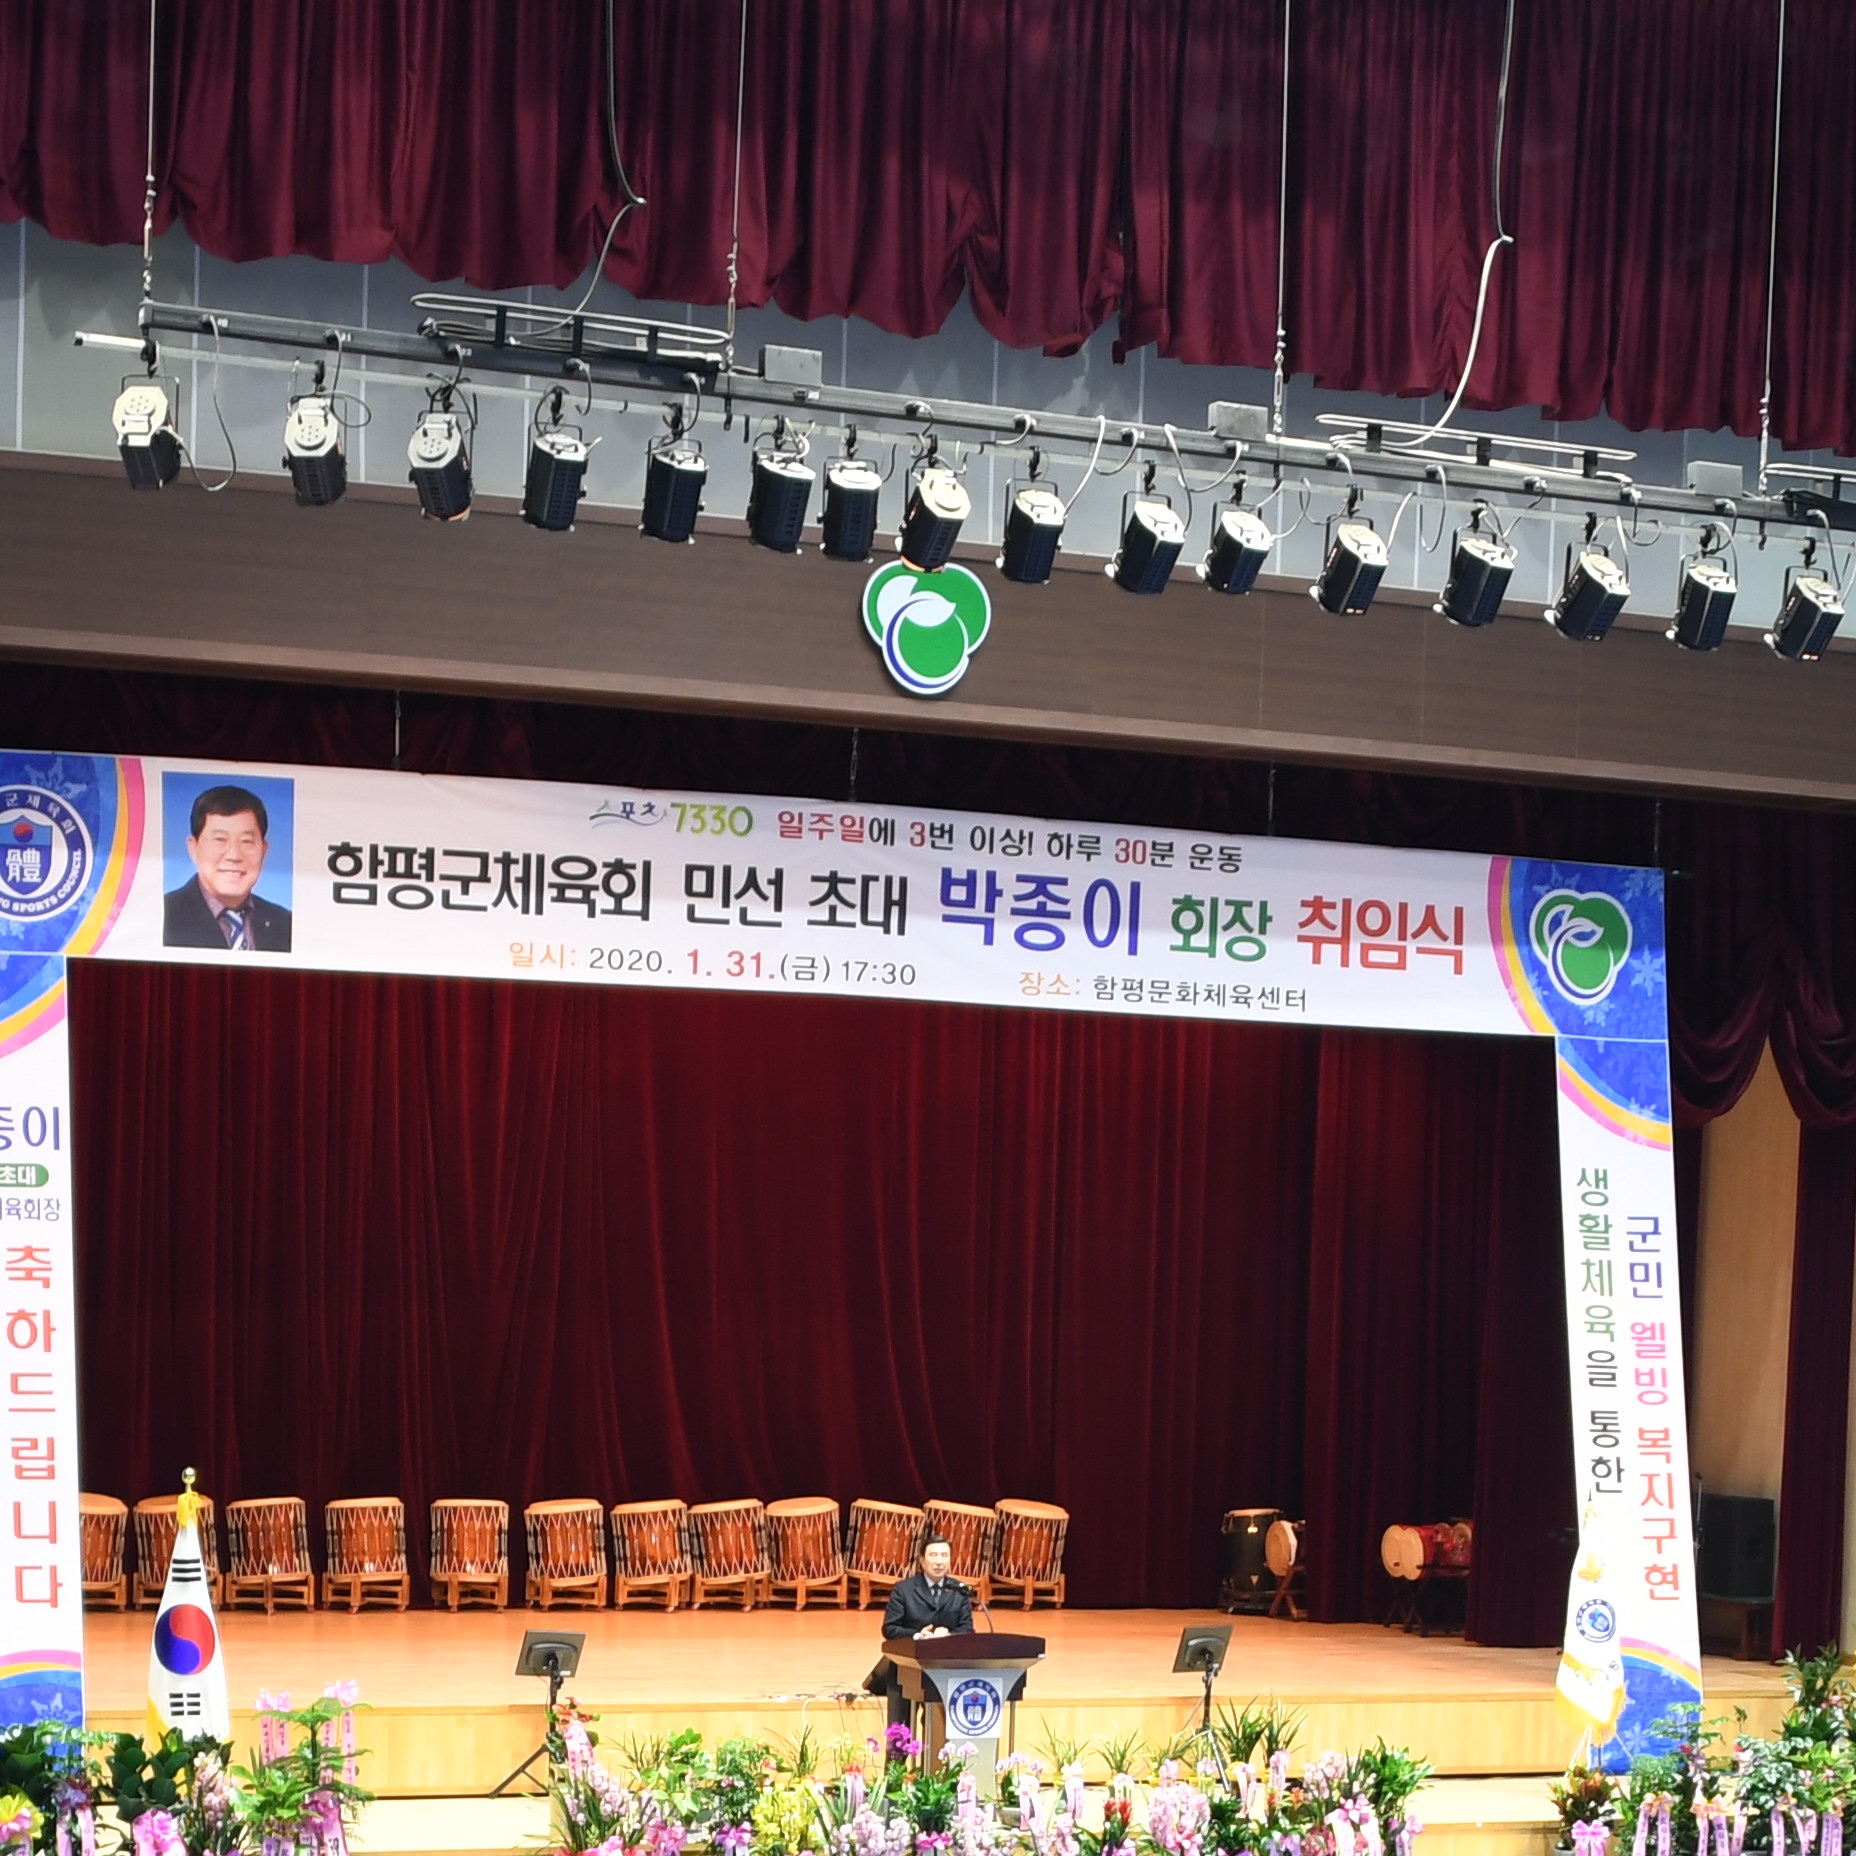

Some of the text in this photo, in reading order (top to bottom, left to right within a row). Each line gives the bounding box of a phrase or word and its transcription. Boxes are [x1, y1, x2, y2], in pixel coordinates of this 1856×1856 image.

[11, 894, 58, 913] SPORTS
[669, 802, 754, 837] 7330
[777, 810, 896, 846] 일주일에
[909, 821, 955, 851] 3번
[970, 825, 1034, 857] 이상!
[1046, 831, 1103, 863] 하루
[1114, 838, 1175, 869] 30분
[1188, 843, 1243, 874] 운동
[326, 841, 1464, 975] 함평군체육회 민선 초대 박종이 회장 취임식
[508, 941, 577, 970] 일시:
[588, 947, 674, 975] 2020.
[686, 949, 713, 977] 1.
[841, 959, 916, 986] 17:30
[1018, 970, 1081, 998] 장소:
[1093, 974, 1307, 1012] 함평문화체육센터
[1576, 1167, 1625, 1493] 생활체육을 통한
[5, 1245, 64, 1609] 축하드립니다
[1626, 1216, 1681, 1601] 군민 웰빙 복지구현
